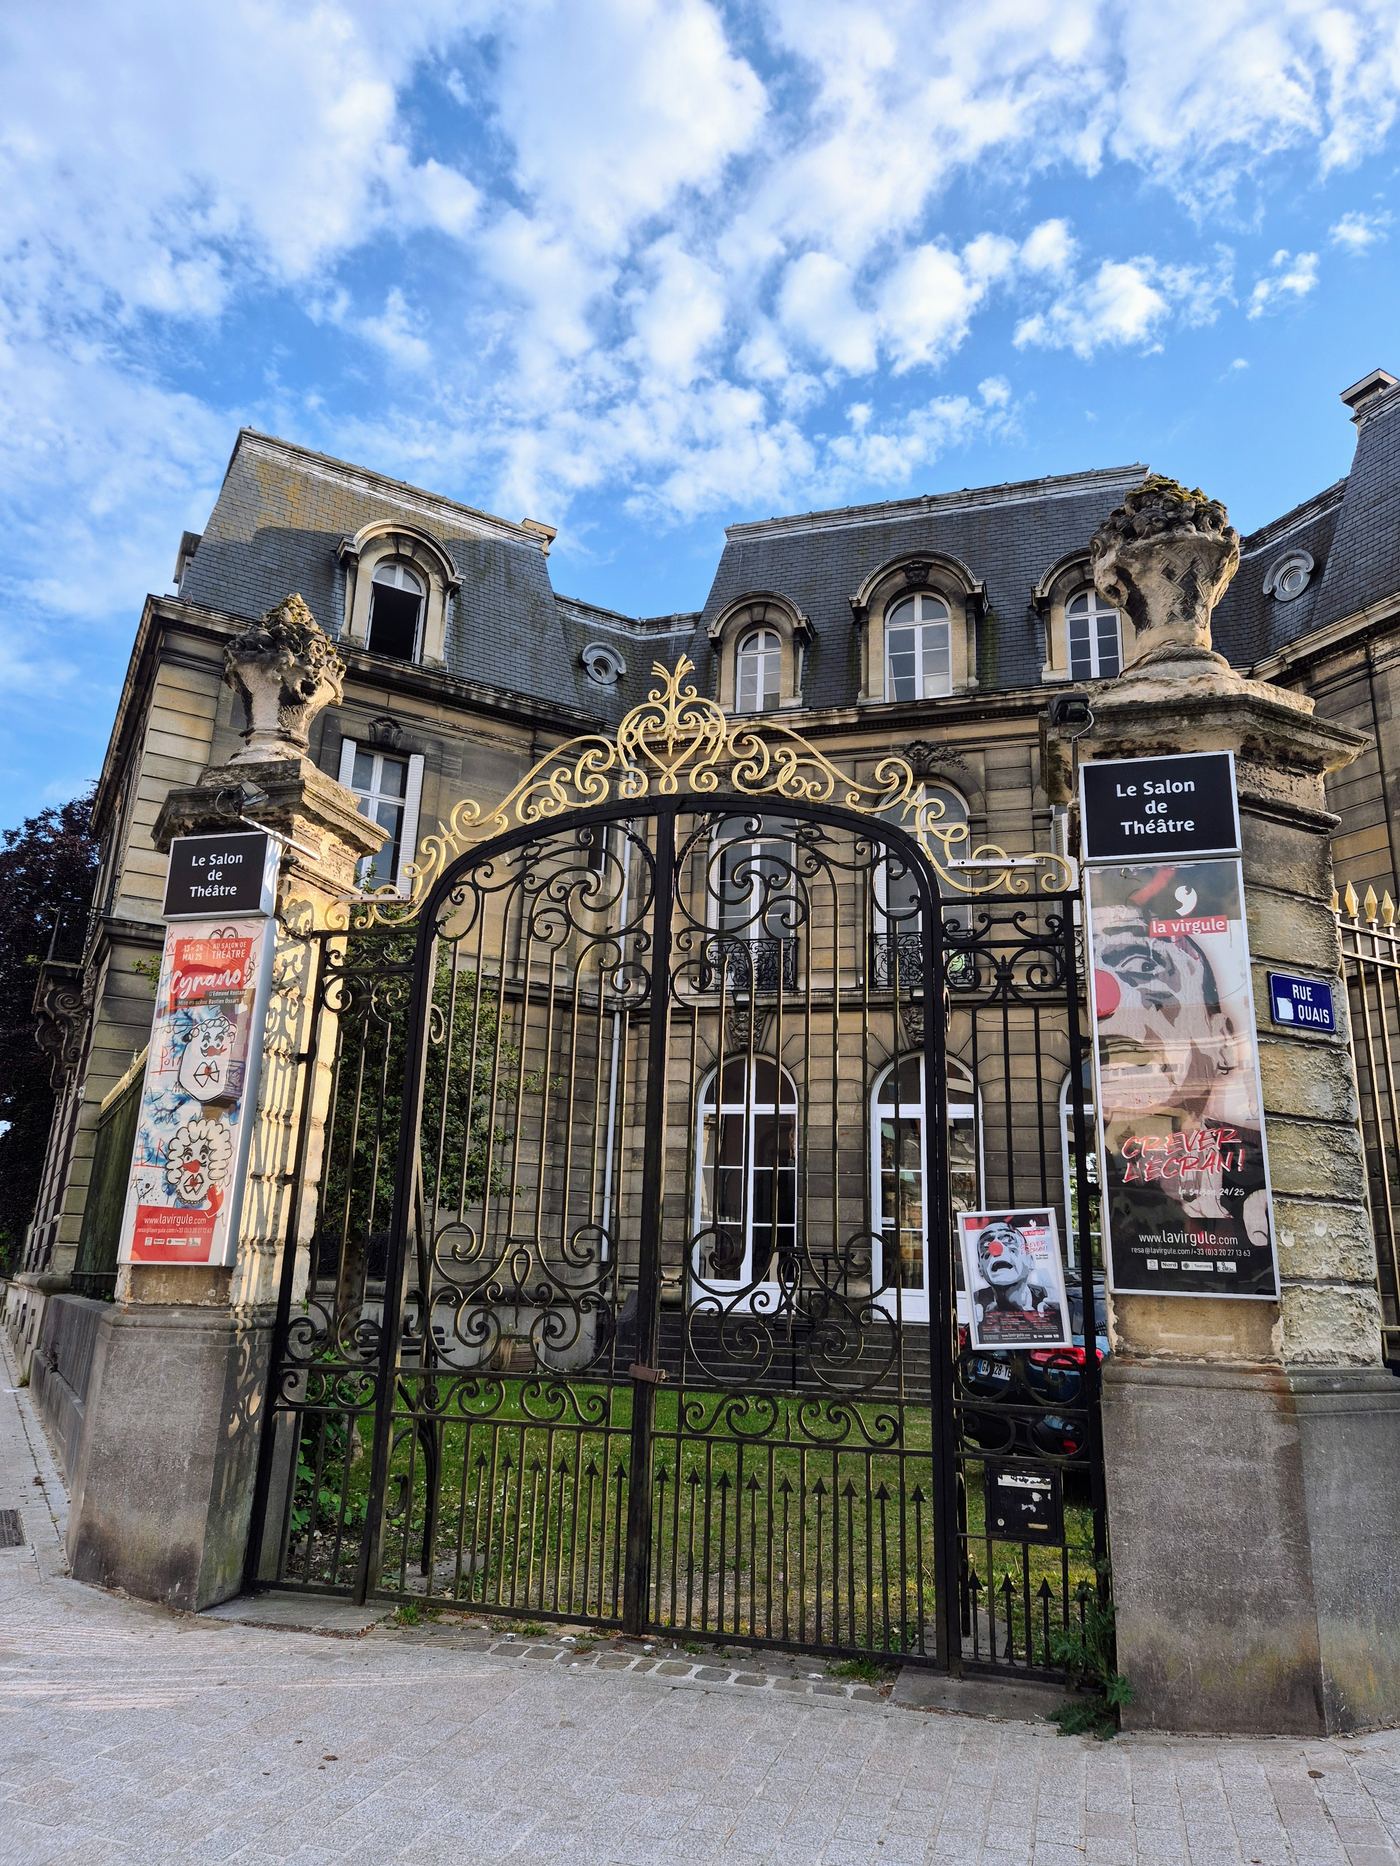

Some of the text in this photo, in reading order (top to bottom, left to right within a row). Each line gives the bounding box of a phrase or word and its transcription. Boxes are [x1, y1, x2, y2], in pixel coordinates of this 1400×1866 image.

[1116, 779, 1195, 797] Le Salon
[1144, 800, 1168, 814] de
[1120, 819, 1195, 835] Théâtre
[191, 852, 243, 867] Le Salon
[207, 868, 223, 881] de
[189, 884, 237, 898] Théâtre
[1152, 919, 1225, 934] la virgule
[221, 941, 239, 950] SALON
[1292, 984, 1313, 1002] RUE
[1298, 1004, 1330, 1024] QUAIS
[1121, 1128, 1242, 1159] CREVER
[1219, 1186, 1245, 1196] 24/25
[144, 1213, 207, 1226] www.lavirgule.com
[1138, 1229, 1239, 1247] www.lavirgule.com
[1219, 1248, 1227, 1256] 20
[1243, 1249, 1251, 1257] 63
